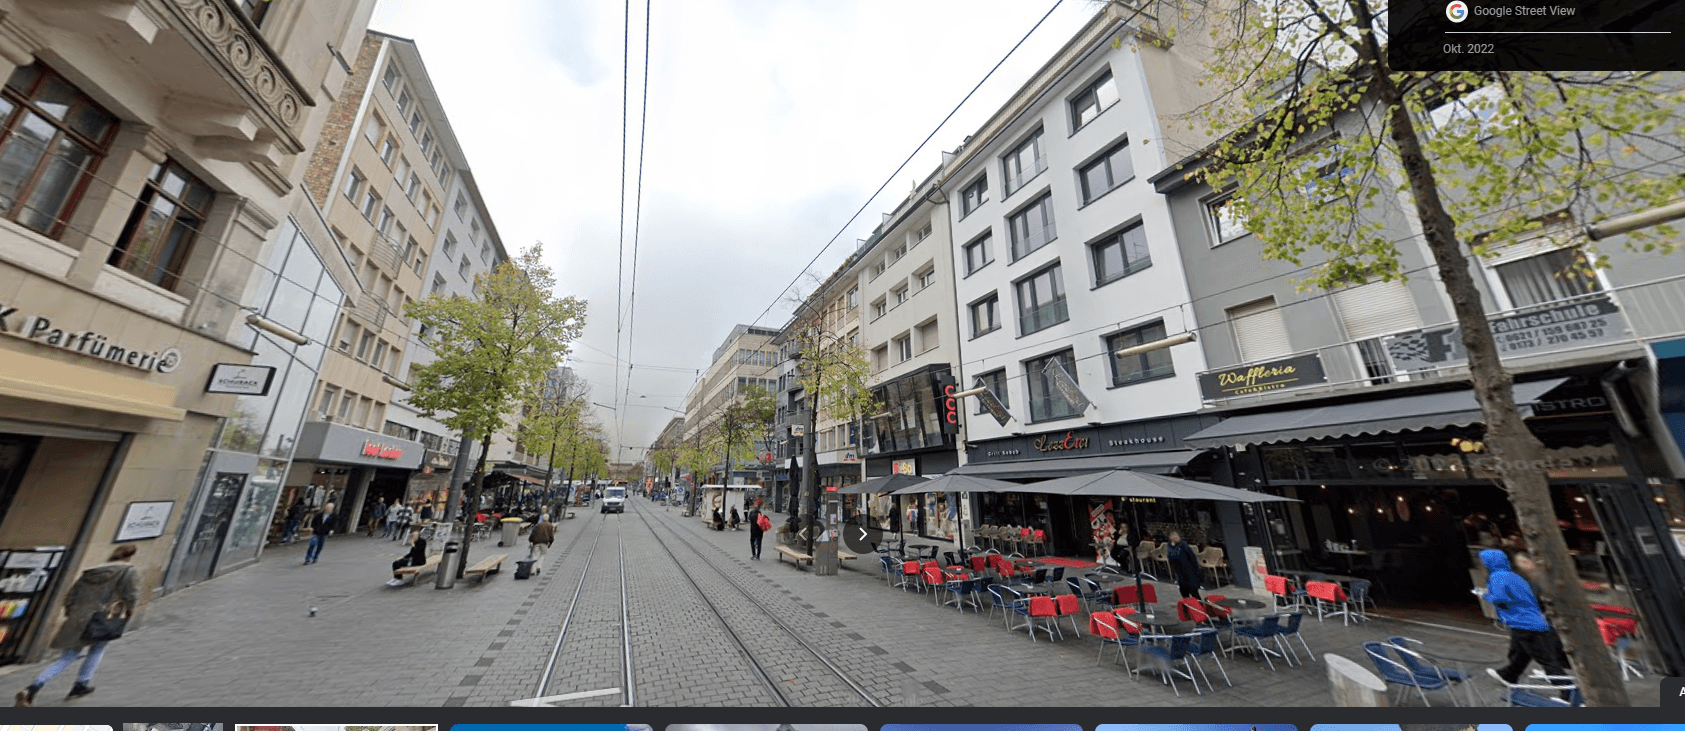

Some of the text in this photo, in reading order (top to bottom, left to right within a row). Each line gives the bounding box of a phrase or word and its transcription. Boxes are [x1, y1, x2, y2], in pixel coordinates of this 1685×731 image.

[1488, 303, 1601, 334] Fahrschule
[28, 316, 170, 374] Parfümerie
[1218, 365, 1296, 386] Waffleria
[1534, 396, 1607, 412] ISTRO
[1109, 435, 1164, 446] Steakhouse
